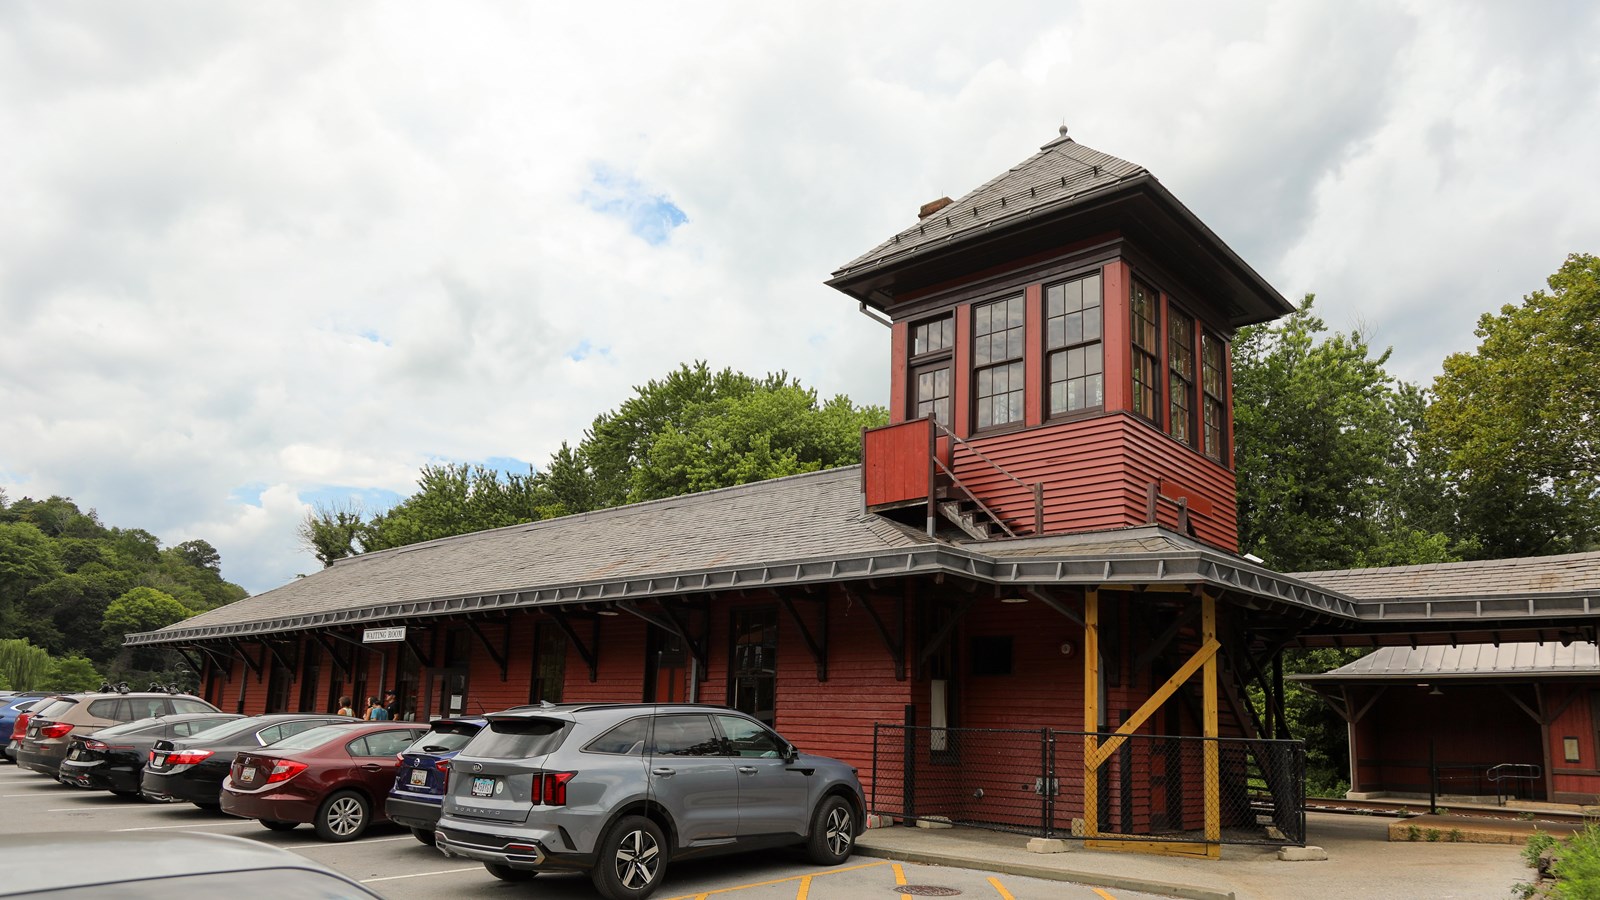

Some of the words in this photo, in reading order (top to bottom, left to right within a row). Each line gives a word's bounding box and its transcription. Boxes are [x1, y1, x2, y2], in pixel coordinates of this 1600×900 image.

[366, 631, 387, 640] WAITING
[387, 629, 403, 639] ROOM
[455, 806, 501, 815] SORENTO
